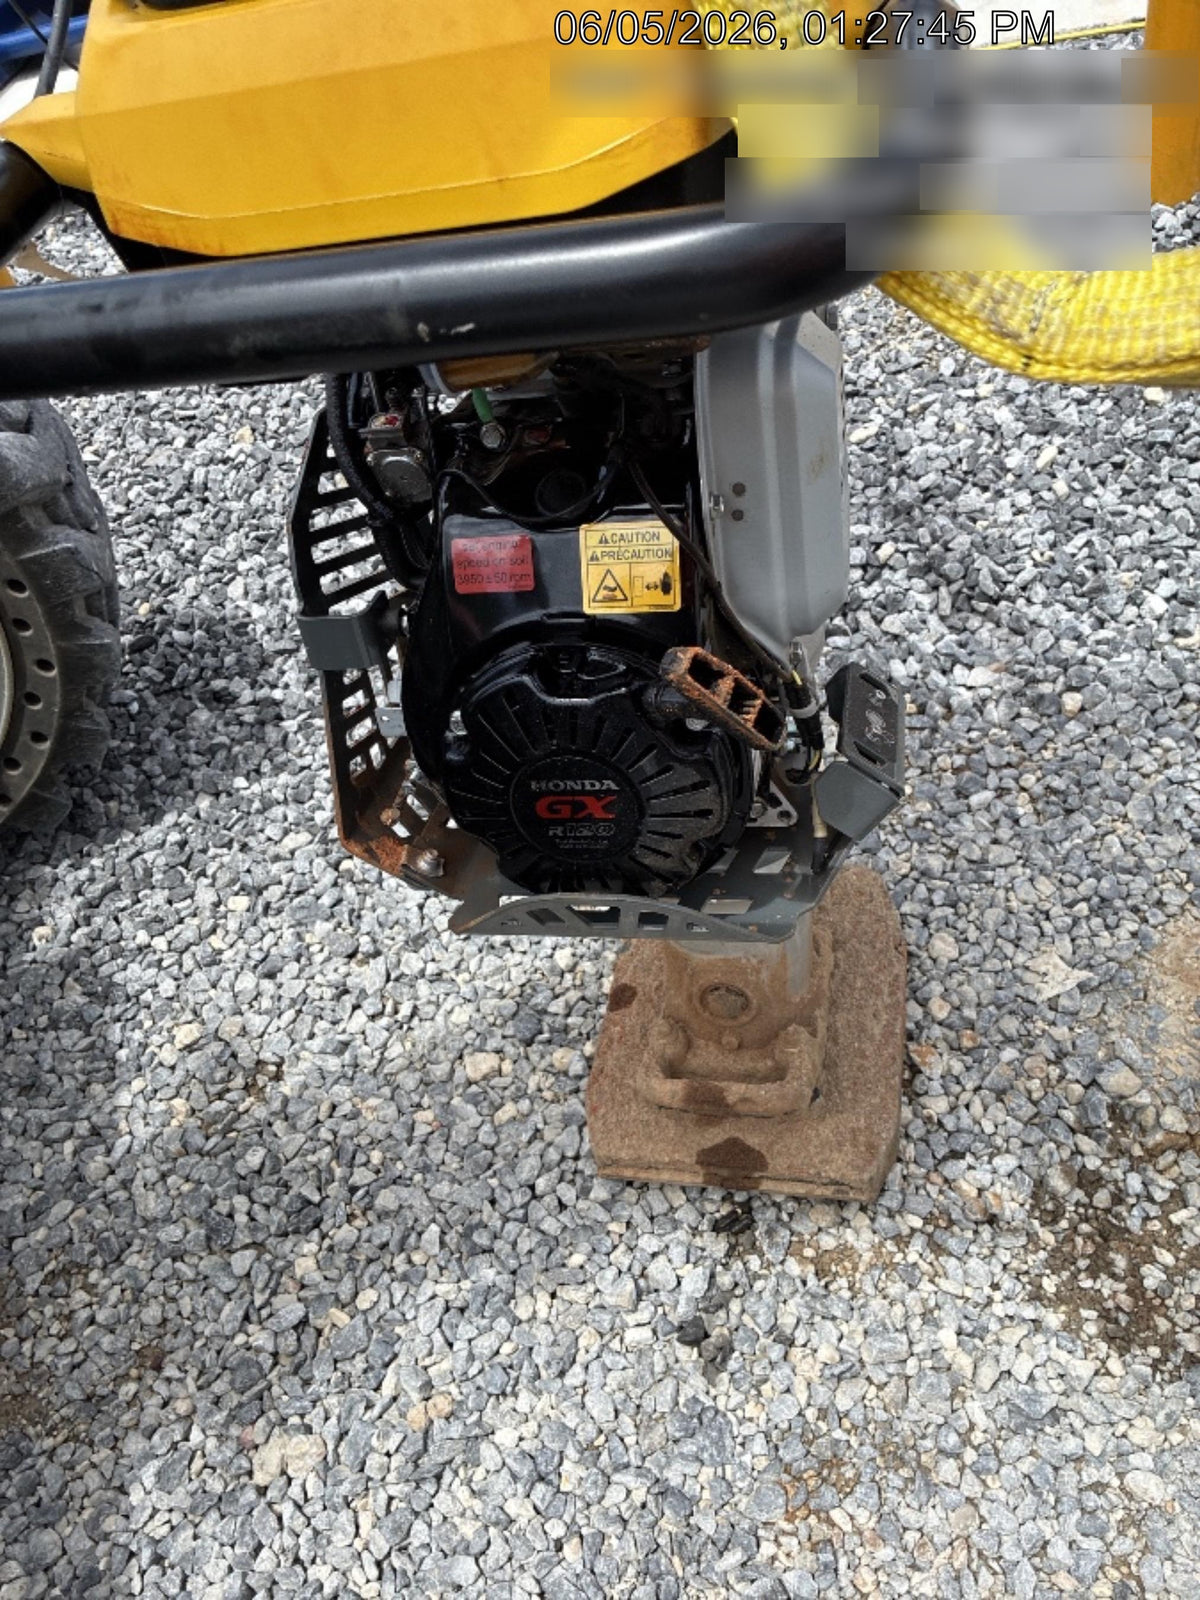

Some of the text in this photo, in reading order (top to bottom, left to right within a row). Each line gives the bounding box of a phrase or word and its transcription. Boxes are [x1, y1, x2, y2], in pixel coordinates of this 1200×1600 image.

[610, 531, 660, 544] CAUTION
[531, 780, 620, 791] HONDA
[536, 795, 617, 818] GX
